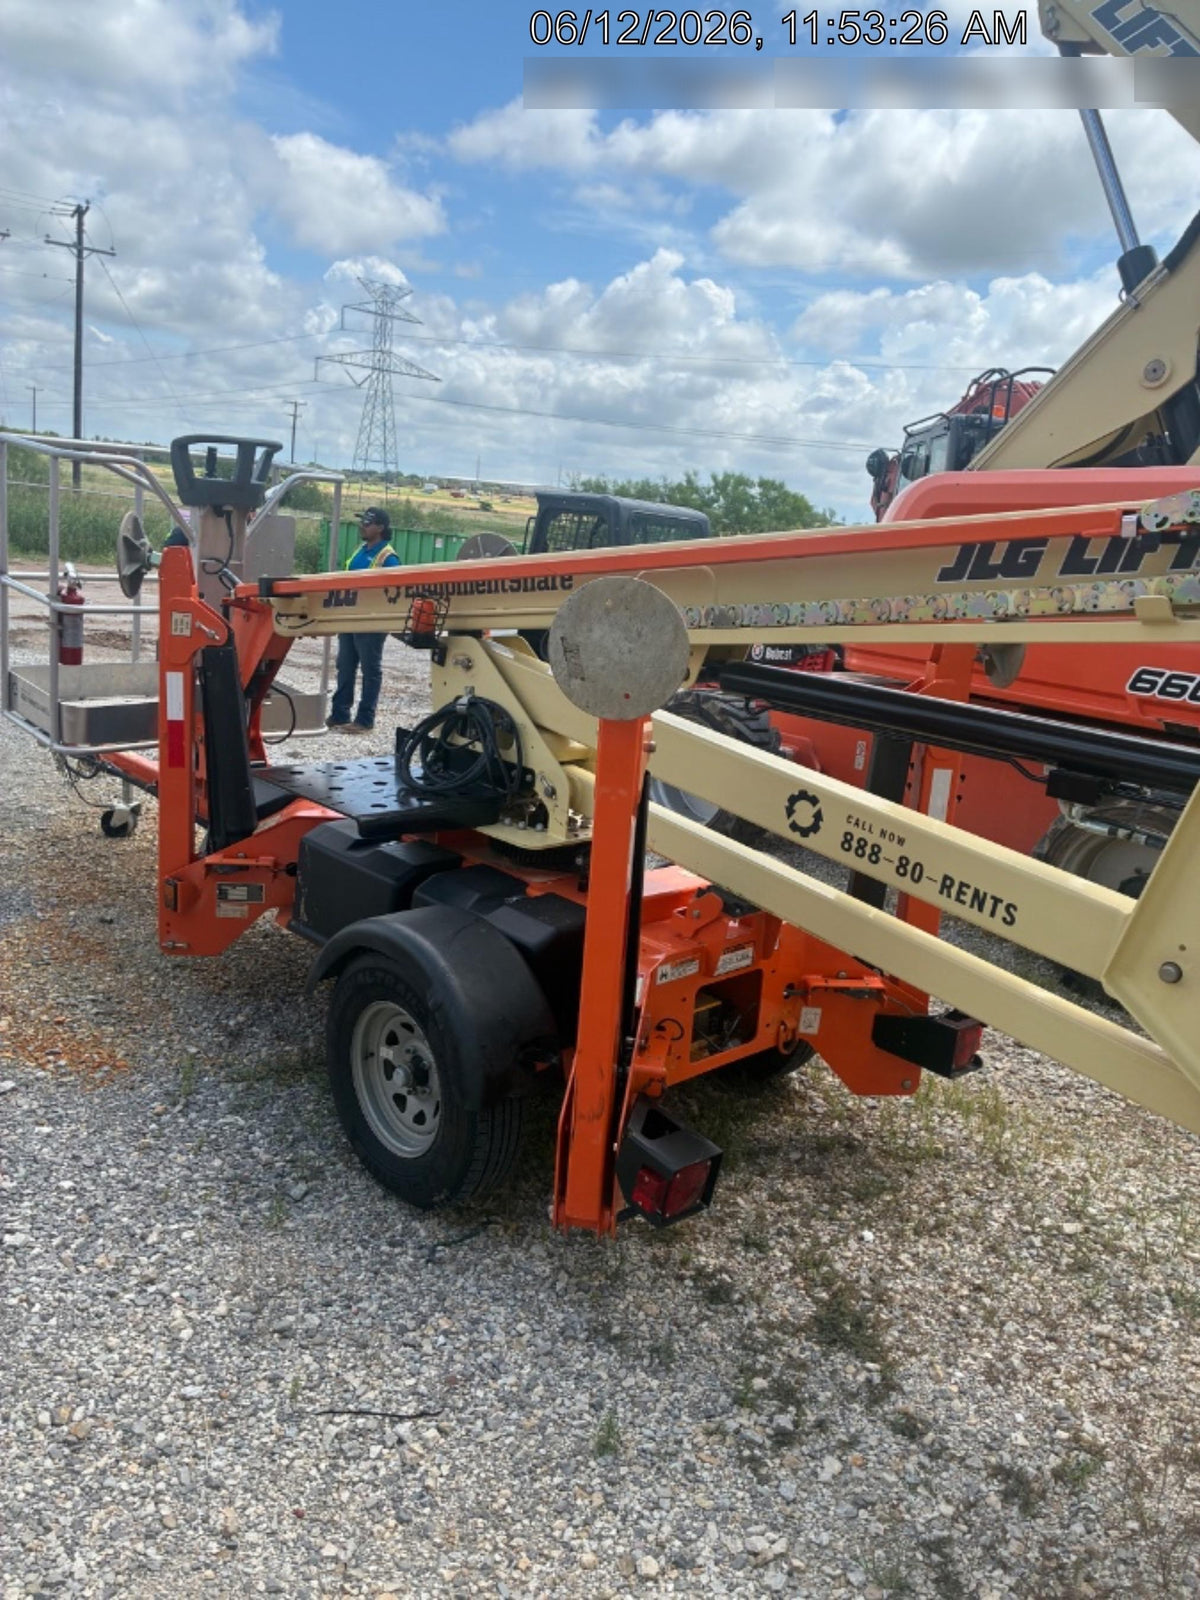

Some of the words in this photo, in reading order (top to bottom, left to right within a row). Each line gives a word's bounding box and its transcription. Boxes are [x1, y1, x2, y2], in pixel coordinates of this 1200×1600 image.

[935, 536, 1050, 583] JLG
[846, 814, 874, 834] CALL
[879, 827, 906, 847] NOW
[840, 831, 1018, 927] 888-80-RENTS
